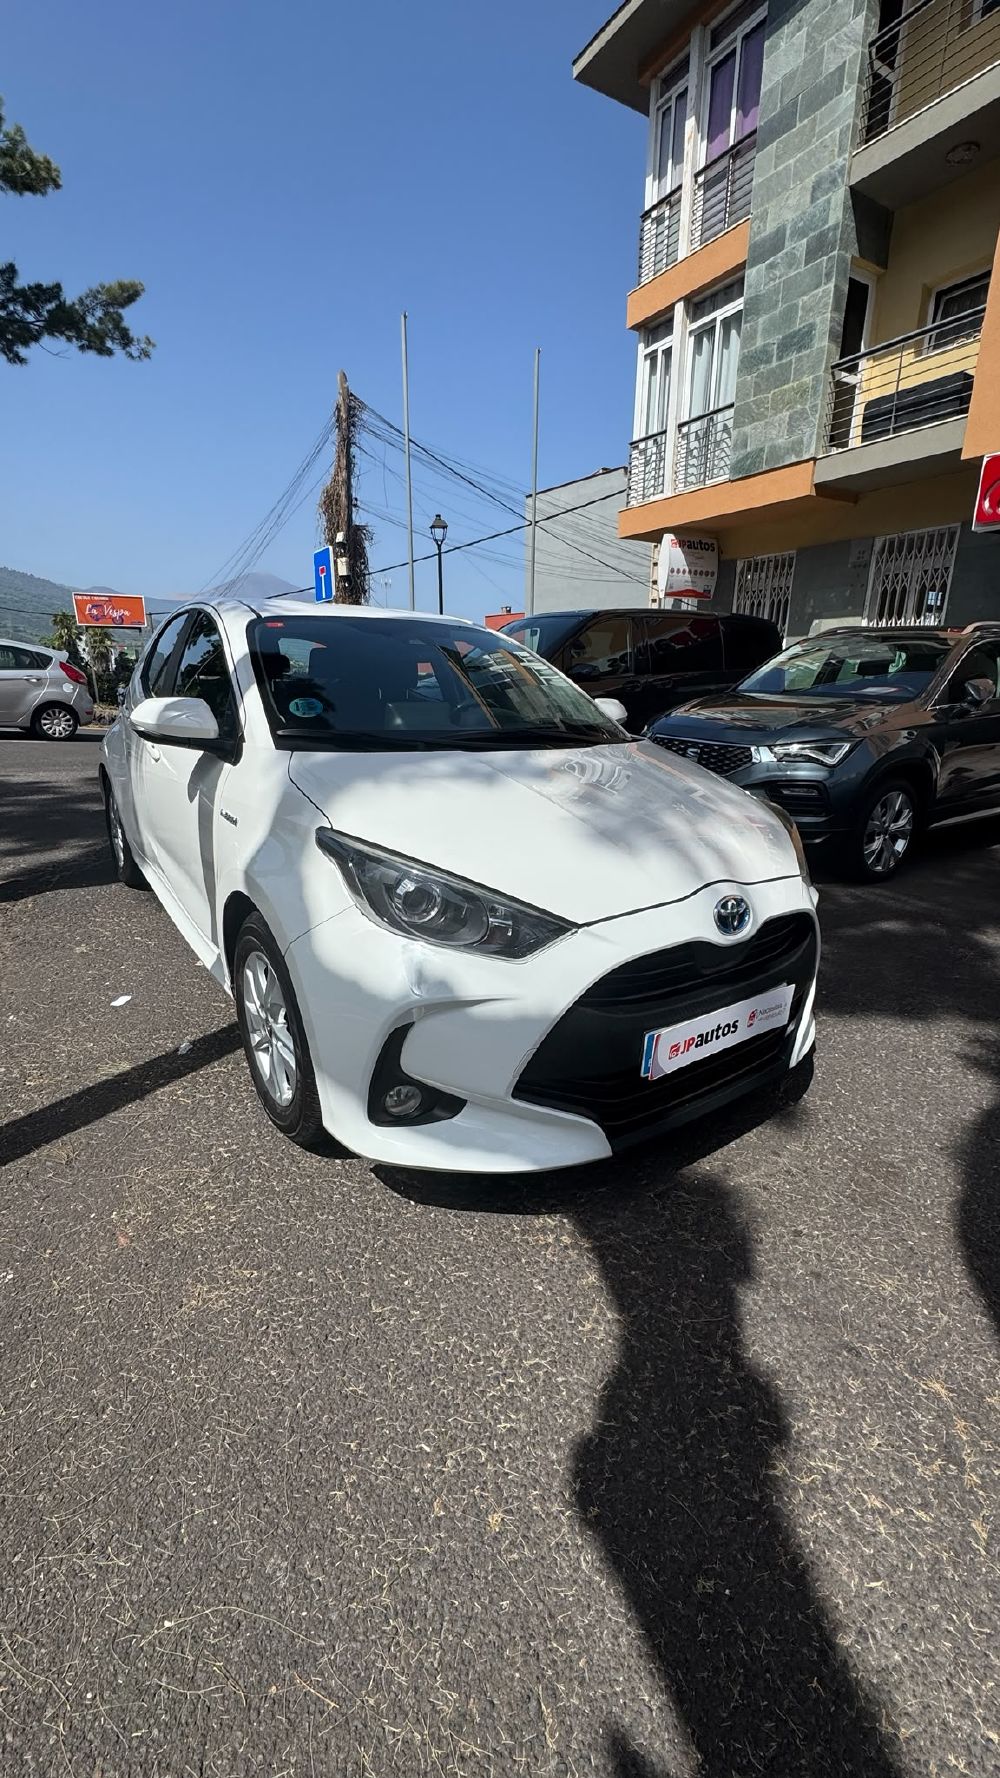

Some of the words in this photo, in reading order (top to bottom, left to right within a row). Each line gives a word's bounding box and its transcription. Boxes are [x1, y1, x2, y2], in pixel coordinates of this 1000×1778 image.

[85, 603, 98, 615] La
[103, 604, 131, 620] Vespa
[680, 1019, 739, 1055] JPautos
